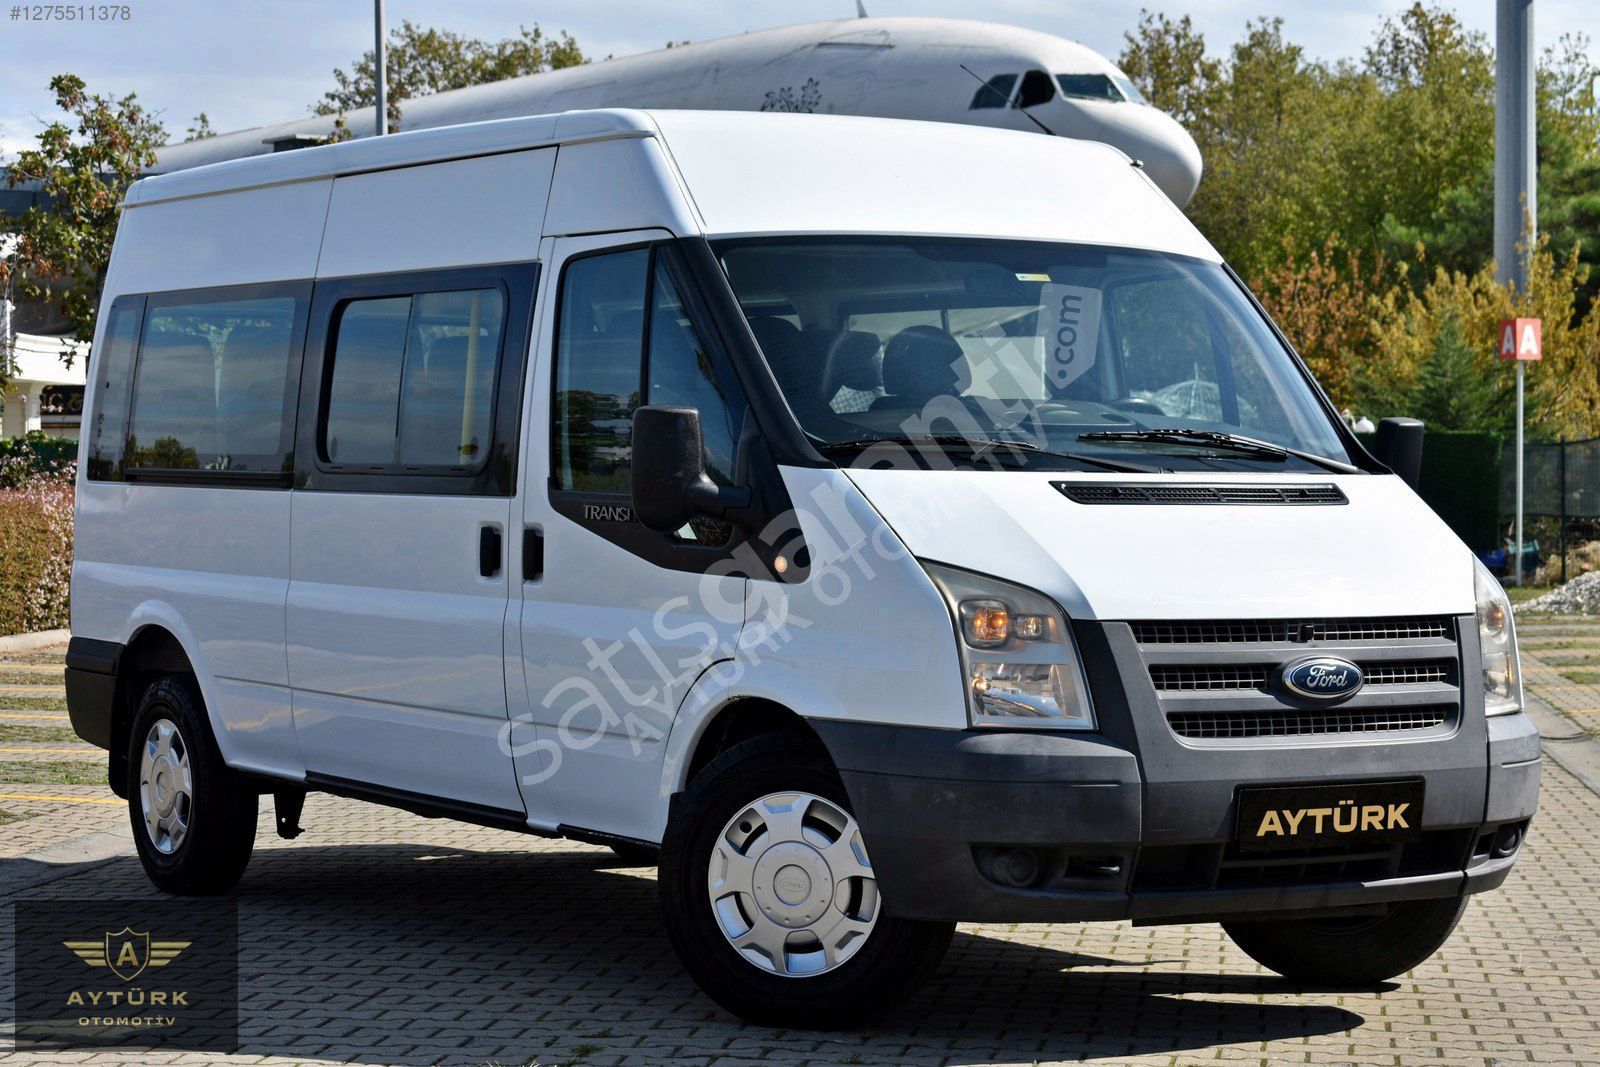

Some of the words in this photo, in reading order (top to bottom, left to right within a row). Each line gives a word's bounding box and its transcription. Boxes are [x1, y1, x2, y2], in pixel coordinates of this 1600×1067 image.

[1502, 325, 1515, 354] A
[1520, 325, 1539, 354] A
[583, 504, 630, 521] TRANSI
[1306, 665, 1347, 688] Ford
[1256, 800, 1410, 837] AYTÜRK
